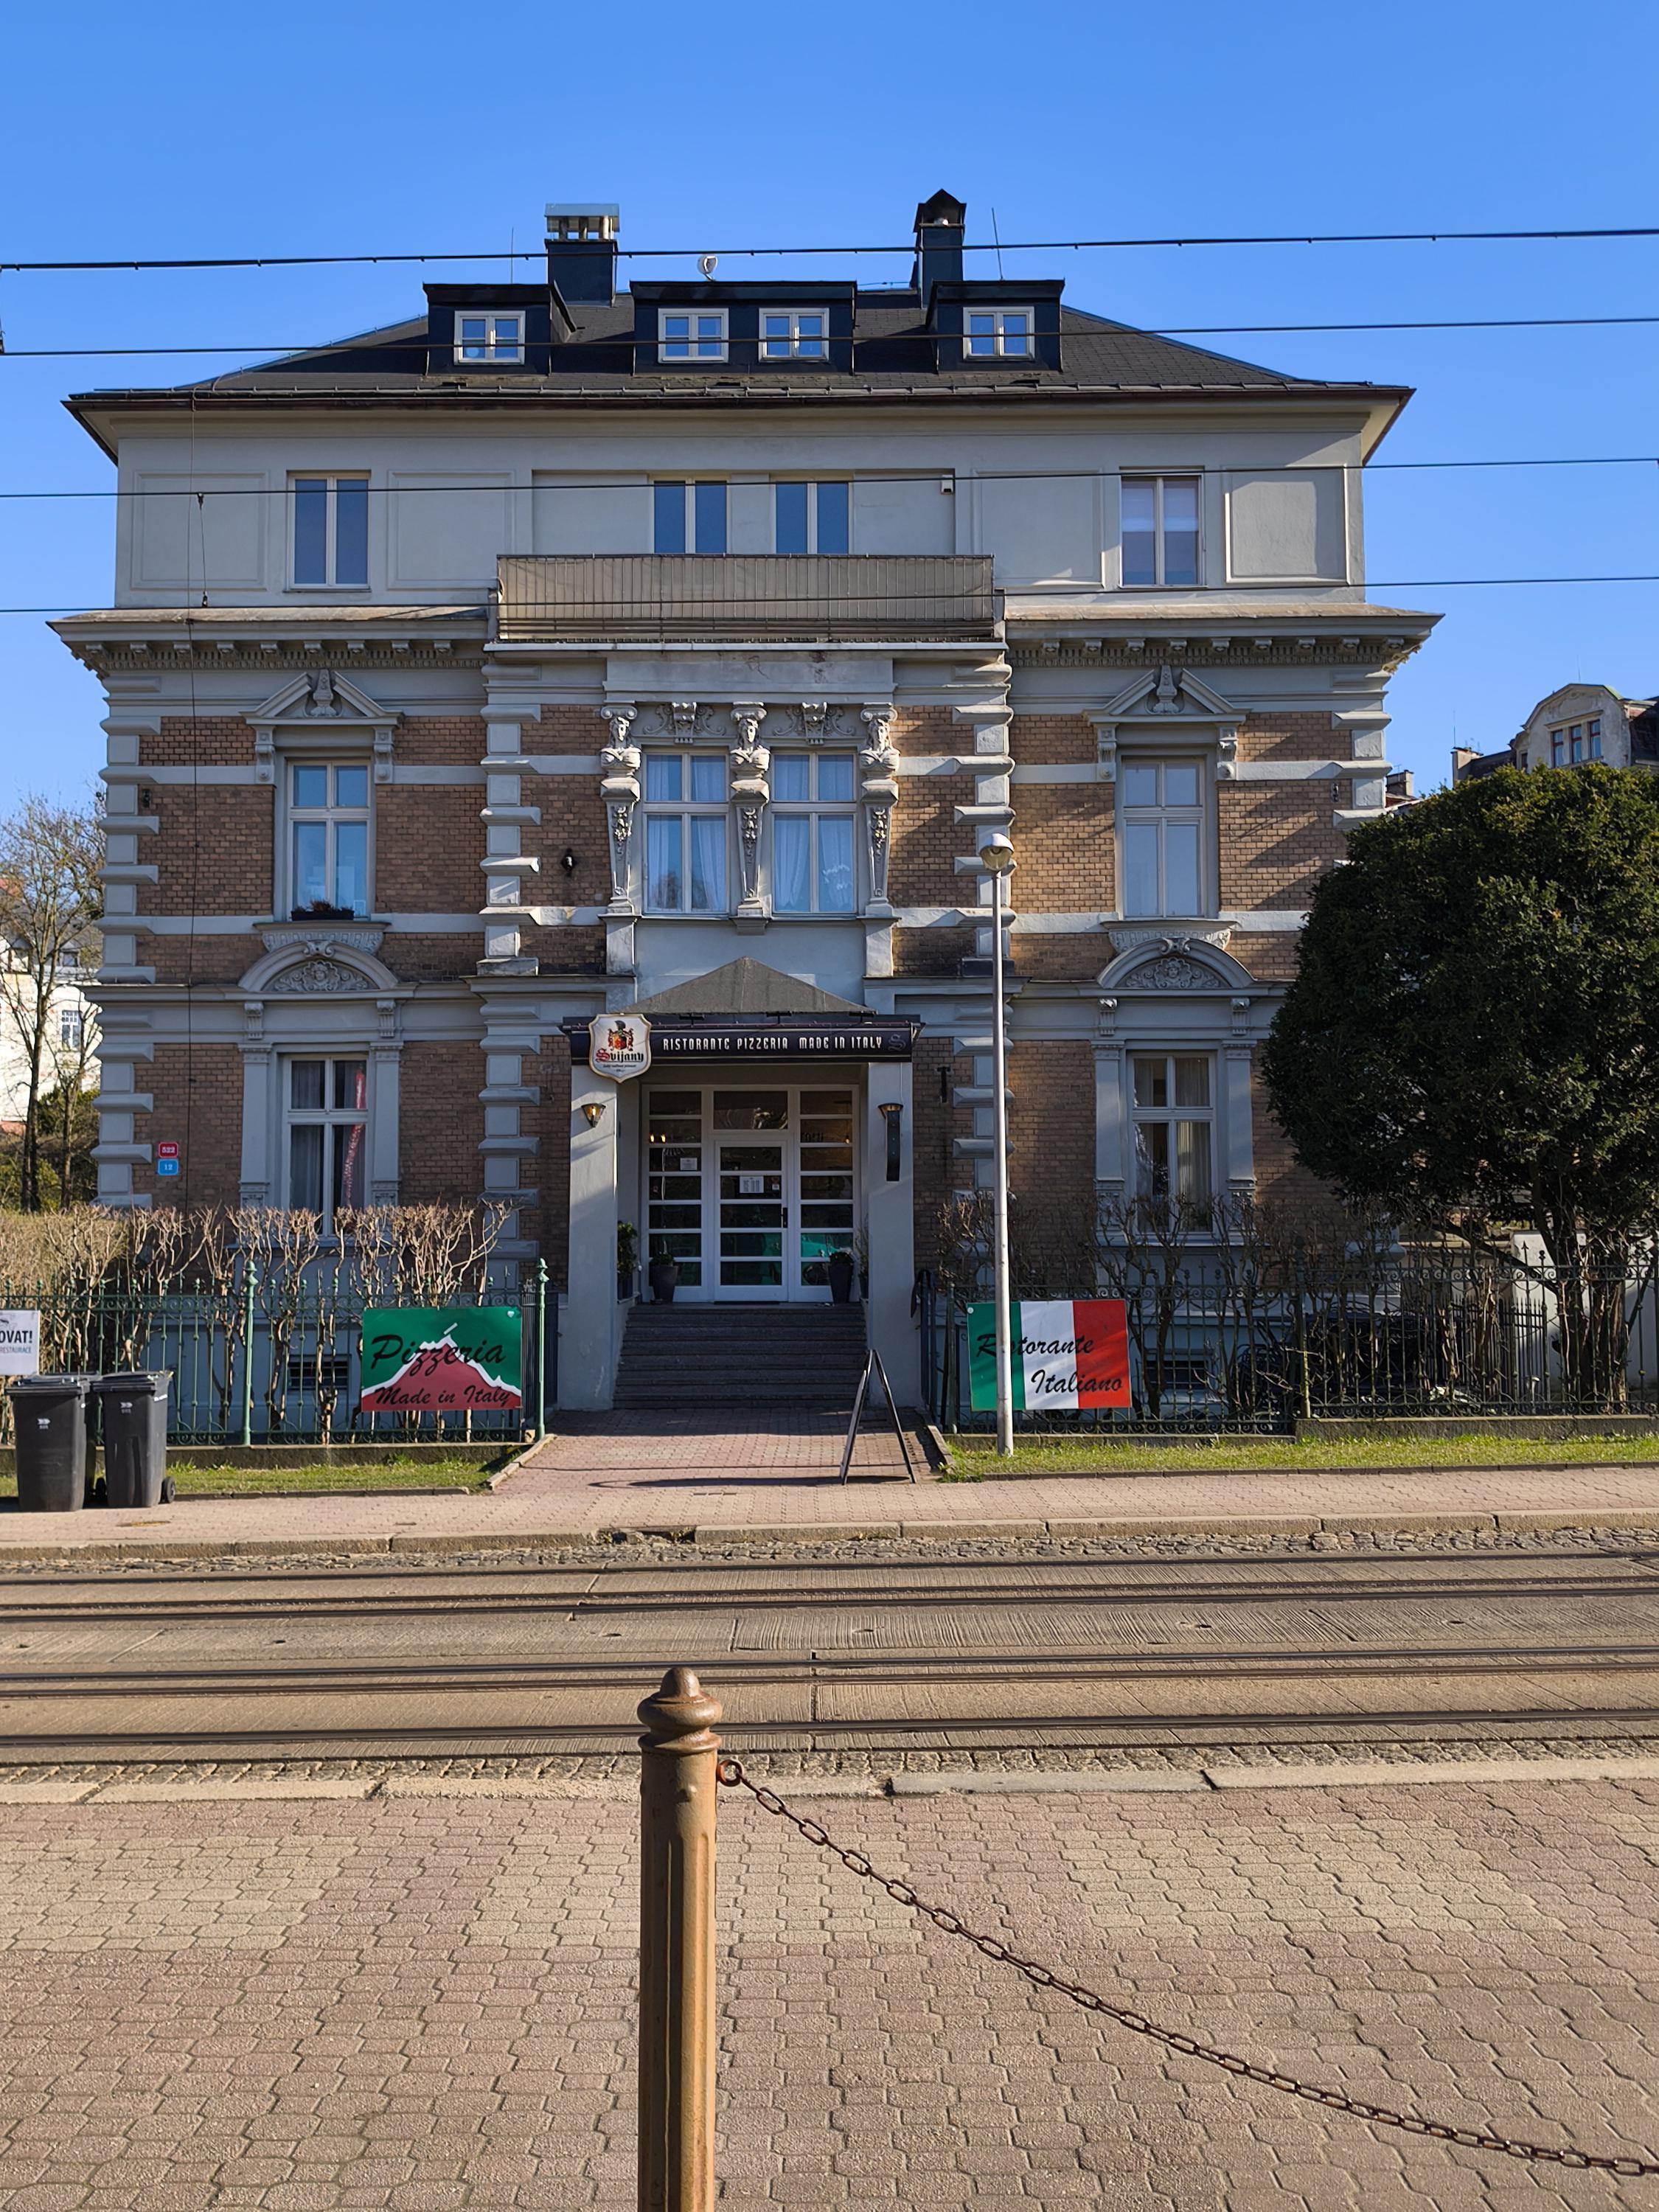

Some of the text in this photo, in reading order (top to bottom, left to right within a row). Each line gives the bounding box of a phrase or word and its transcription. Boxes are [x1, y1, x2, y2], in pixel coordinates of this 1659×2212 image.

[596, 1048, 644, 1062] Svijany
[663, 1036, 882, 1051] RISTORANTE PIZZERIA MADE IN ITALY
[371, 1334, 506, 1377] Pizzeria
[976, 1333, 1094, 1357] Rtorante
[1031, 1369, 1123, 1394] Italiano
[374, 1385, 509, 1407] Made in Italy
